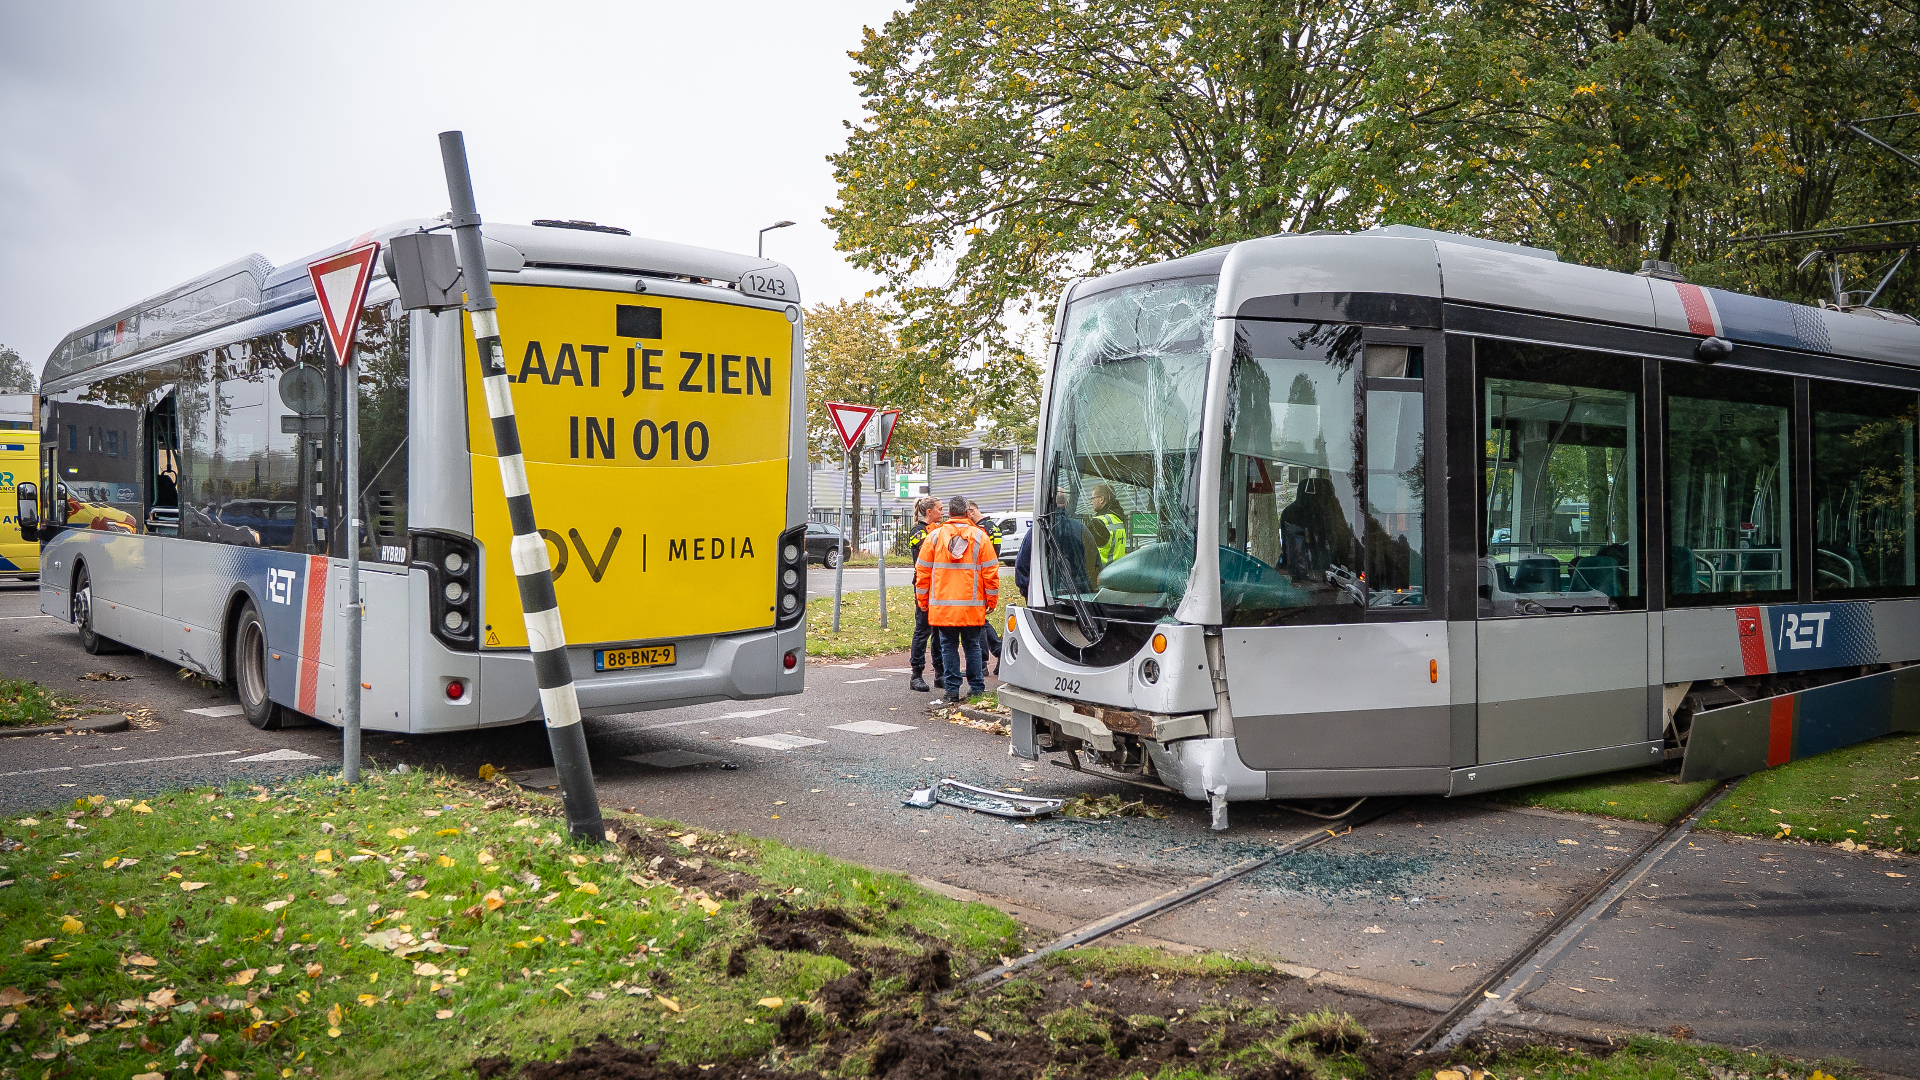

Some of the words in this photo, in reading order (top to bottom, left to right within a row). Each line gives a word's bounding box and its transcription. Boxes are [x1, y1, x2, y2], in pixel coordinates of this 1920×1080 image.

[749, 274, 786, 296] 1243
[507, 340, 609, 388] AAT
[621, 347, 664, 399] JE
[678, 351, 772, 397] ZIEN
[569, 415, 616, 460] IN
[632, 418, 710, 462] 010
[381, 545, 407, 563] HYBRID
[668, 537, 755, 561] MEDIA
[266, 567, 297, 606] RET
[1778, 612, 1831, 651] RET
[608, 648, 671, 666] 88-BNZ-9
[1054, 676, 1081, 694] 2042
